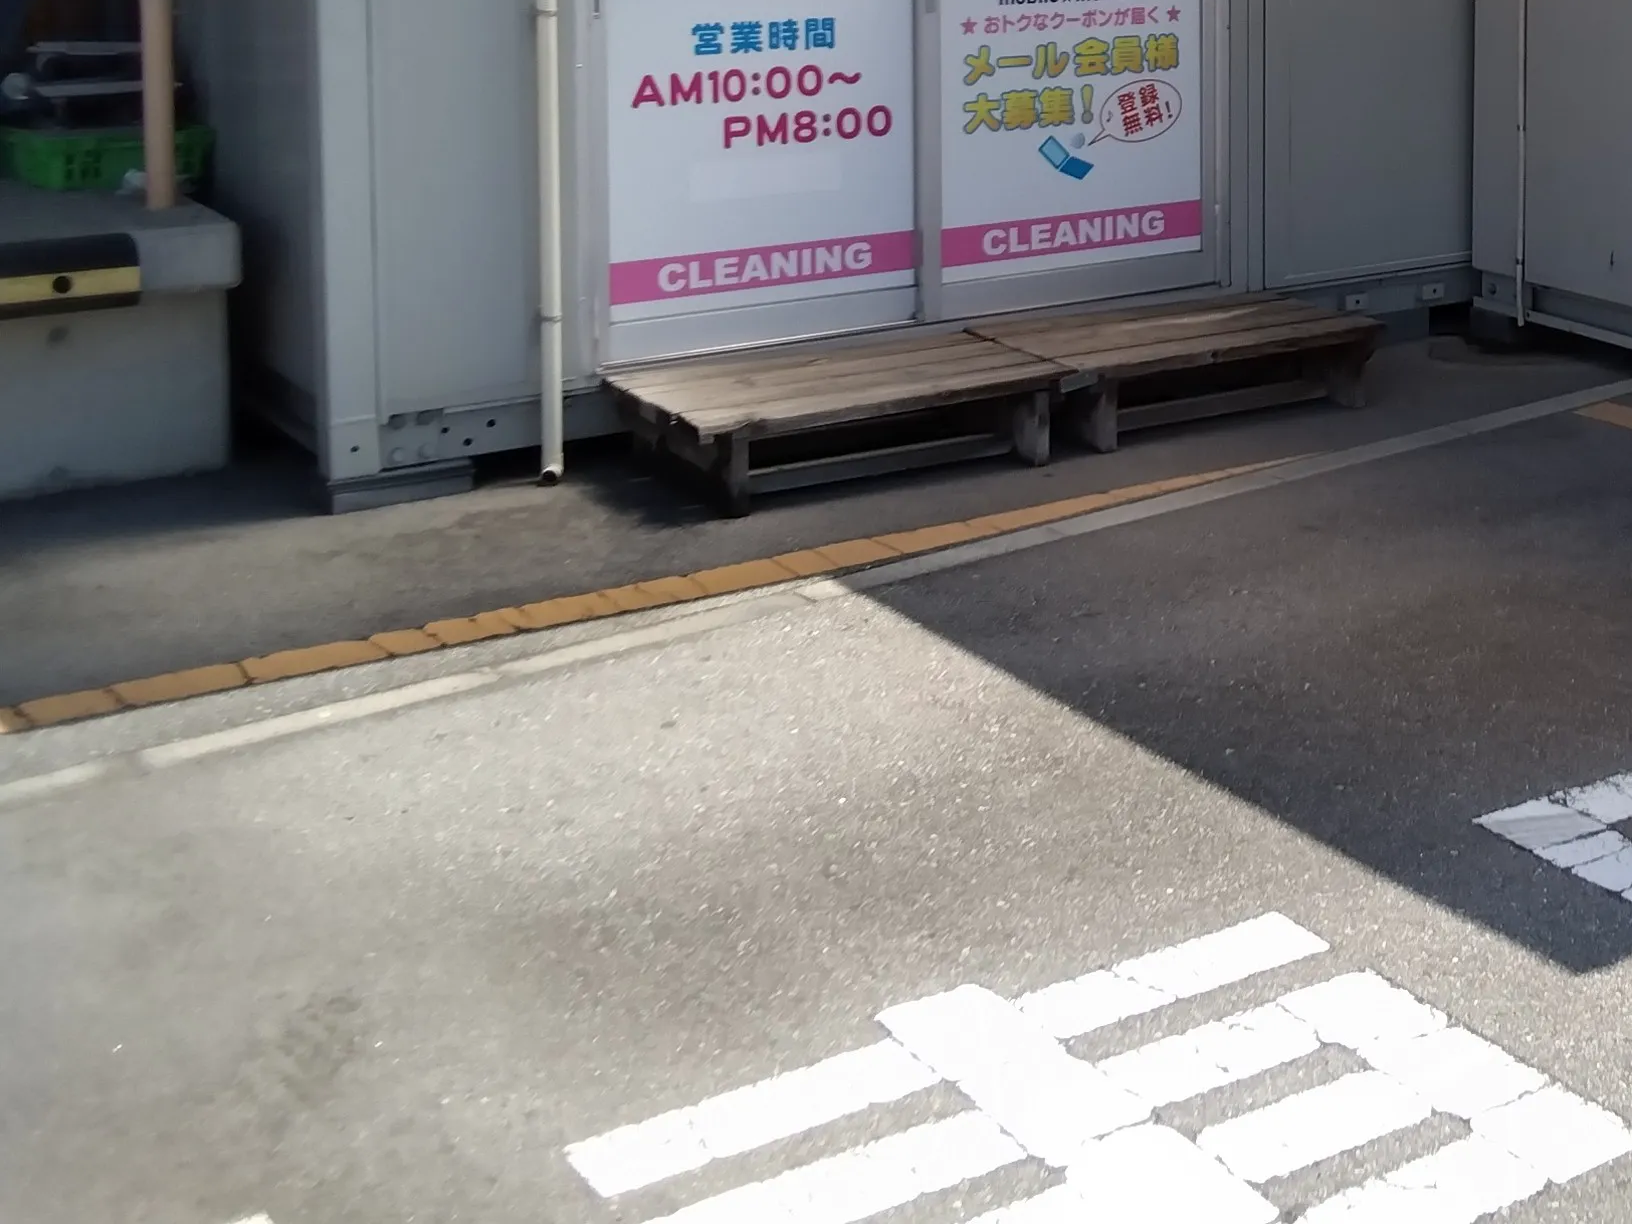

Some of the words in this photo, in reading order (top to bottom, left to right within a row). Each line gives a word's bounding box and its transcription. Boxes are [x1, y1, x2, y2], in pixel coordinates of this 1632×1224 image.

[691, 17, 837, 57] 営業時間
[983, 5, 1160, 34] おトクなクーポンが届く
[963, 32, 1181, 86] メール会員様
[723, 105, 893, 150] PM8:00
[963, 83, 1095, 136] 大募集!
[981, 209, 1166, 258] CLEANING
[657, 241, 874, 294] CLEANING
